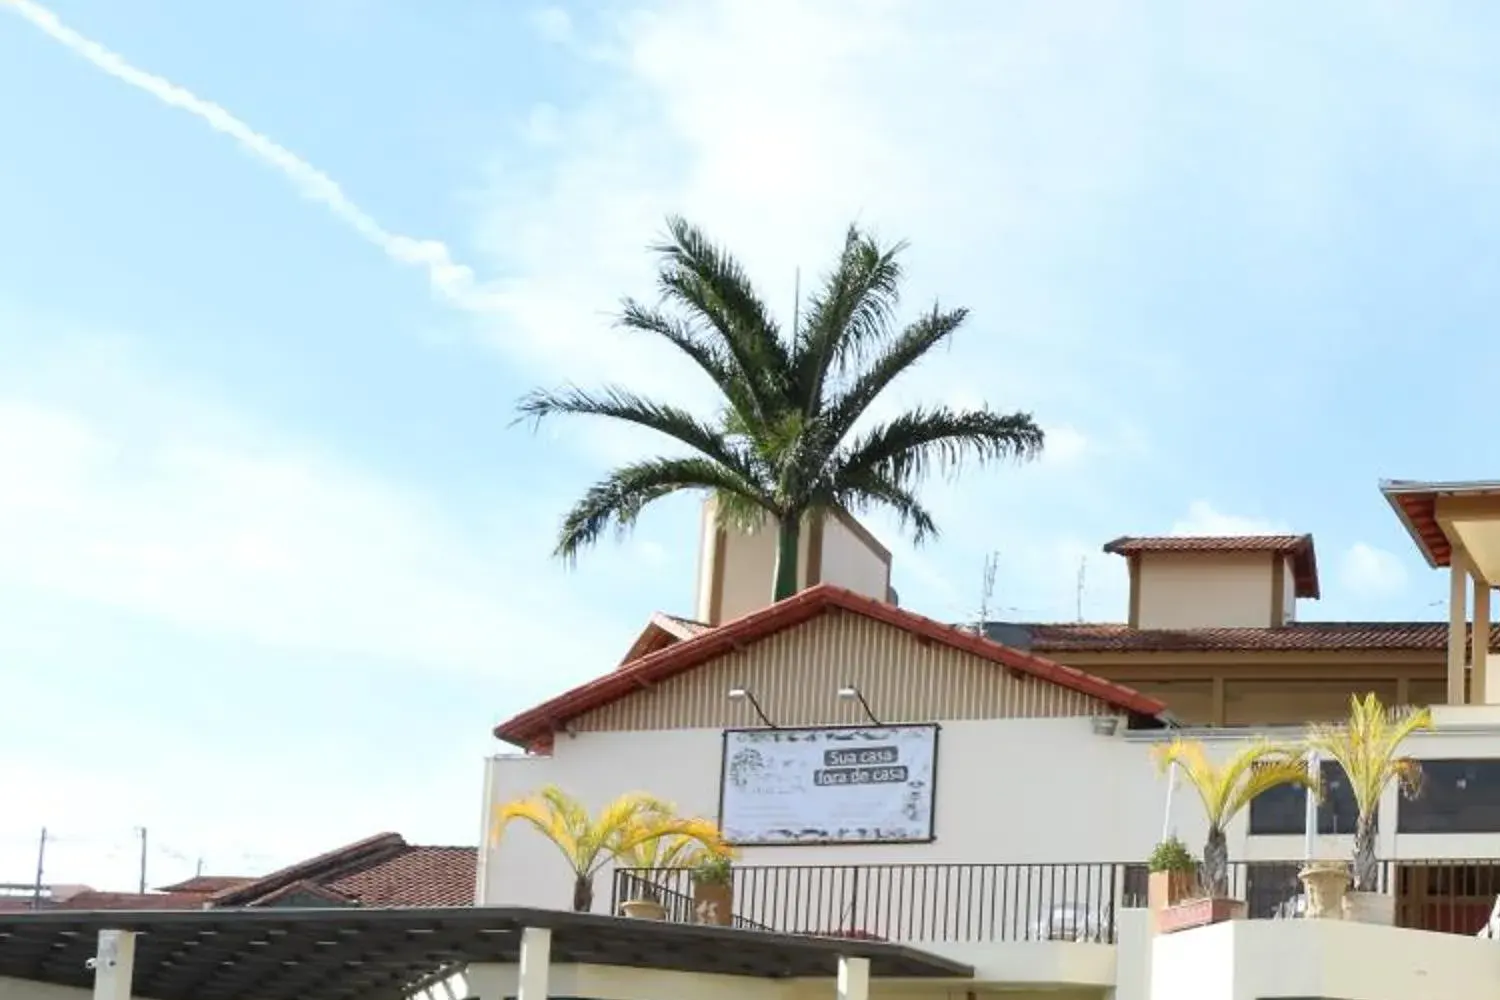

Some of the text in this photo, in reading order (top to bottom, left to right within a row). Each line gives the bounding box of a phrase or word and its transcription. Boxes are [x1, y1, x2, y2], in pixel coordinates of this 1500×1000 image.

[830, 750, 894, 765] Sua casa
[816, 768, 846, 786] fora
[851, 767, 869, 783] de
[873, 767, 905, 781] casa
